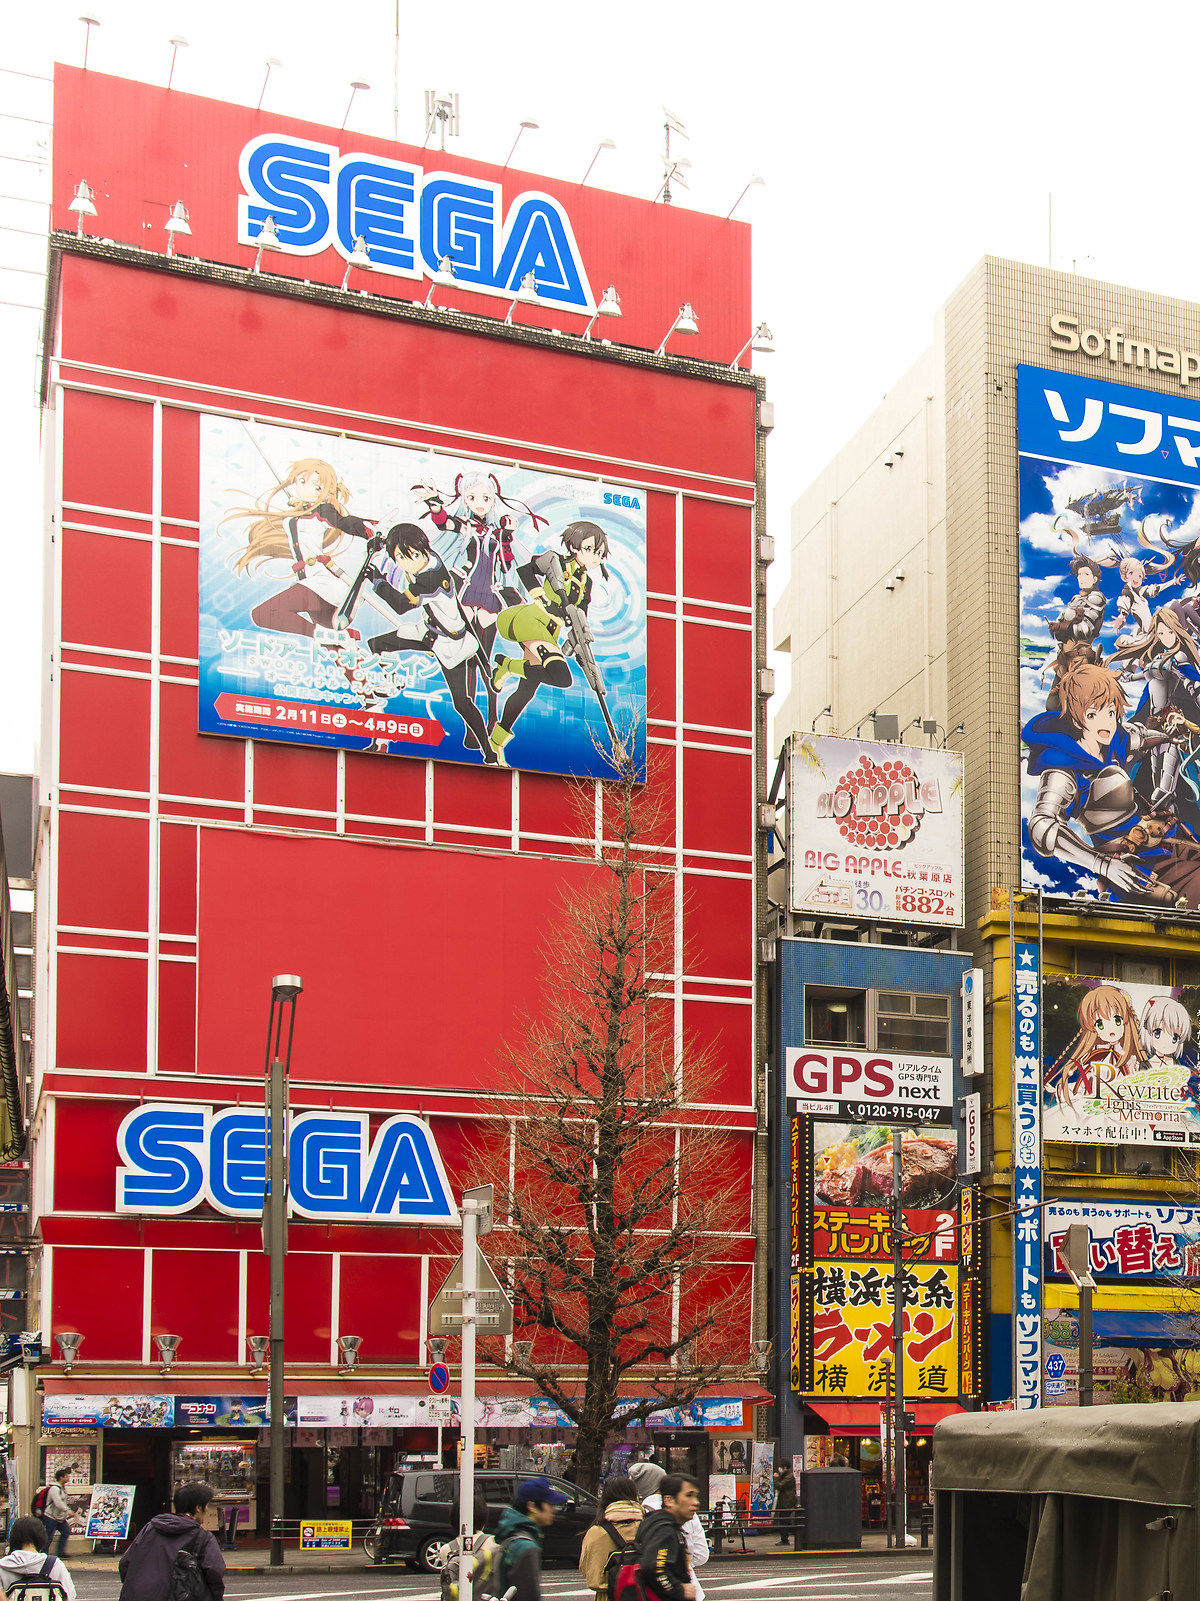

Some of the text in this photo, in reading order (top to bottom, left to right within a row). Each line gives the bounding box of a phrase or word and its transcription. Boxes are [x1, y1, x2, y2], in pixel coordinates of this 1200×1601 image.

[239, 134, 597, 315] SEGA
[604, 492, 641, 510] SEGA
[218, 630, 441, 679] ソードアート・オンライン
[249, 655, 417, 688] SWORD ART ONLINE
[235, 703, 271, 716] 実施期間
[817, 778, 943, 819] BIG APPLE
[805, 850, 840, 871] BIG
[907, 870, 953, 884] 秋葉原店
[895, 885, 955, 899] パチンコ・スロット
[902, 895, 955, 916] 882台
[1015, 969, 1038, 1052] 売るのも
[793, 1054, 895, 1098] GPS
[898, 1063, 942, 1074] リアルタイム
[898, 1073, 940, 1083] GPS専門店
[898, 1085, 941, 1100] next
[1091, 1062, 1184, 1101] Rewrite
[802, 1102, 834, 1112] 当ビル4F
[858, 1103, 941, 1121] 0120-915-047
[1099, 1095, 1141, 1113] Ignis
[1016, 1081, 1038, 1165] 買うのも
[1119, 1109, 1180, 1123] Memoria
[968, 1109, 976, 1157] GPS
[1062, 1125, 1148, 1140] スマホで配信中!
[117, 1103, 460, 1225] SEGA
[791, 1117, 800, 1252] ステーキ&ハンバーグ
[962, 1196, 971, 1253] ラーメン
[1048, 1207, 1081, 1217] 売るのも
[1082, 1207, 1113, 1218] 買うのも
[1114, 1208, 1152, 1219] サポートも
[830, 1233, 931, 1256] ハンバーグ
[935, 1213, 955, 1258] 2F
[791, 1254, 800, 1267] 2F
[963, 1255, 971, 1268] 1F
[1016, 1195, 1039, 1310] サポートも
[814, 1266, 955, 1310] 横浜家系
[791, 1286, 800, 1363] ラーメン
[814, 1309, 955, 1363] ラーメン
[962, 1282, 971, 1371] ステーキ&ハンバーグ
[1018, 1320, 1039, 1410] ソフマップ
[1047, 1360, 1064, 1371] 437
[815, 1364, 950, 1393] 横浜道
[966, 1373, 972, 1393] 2F
[189, 1403, 216, 1415] コナン
